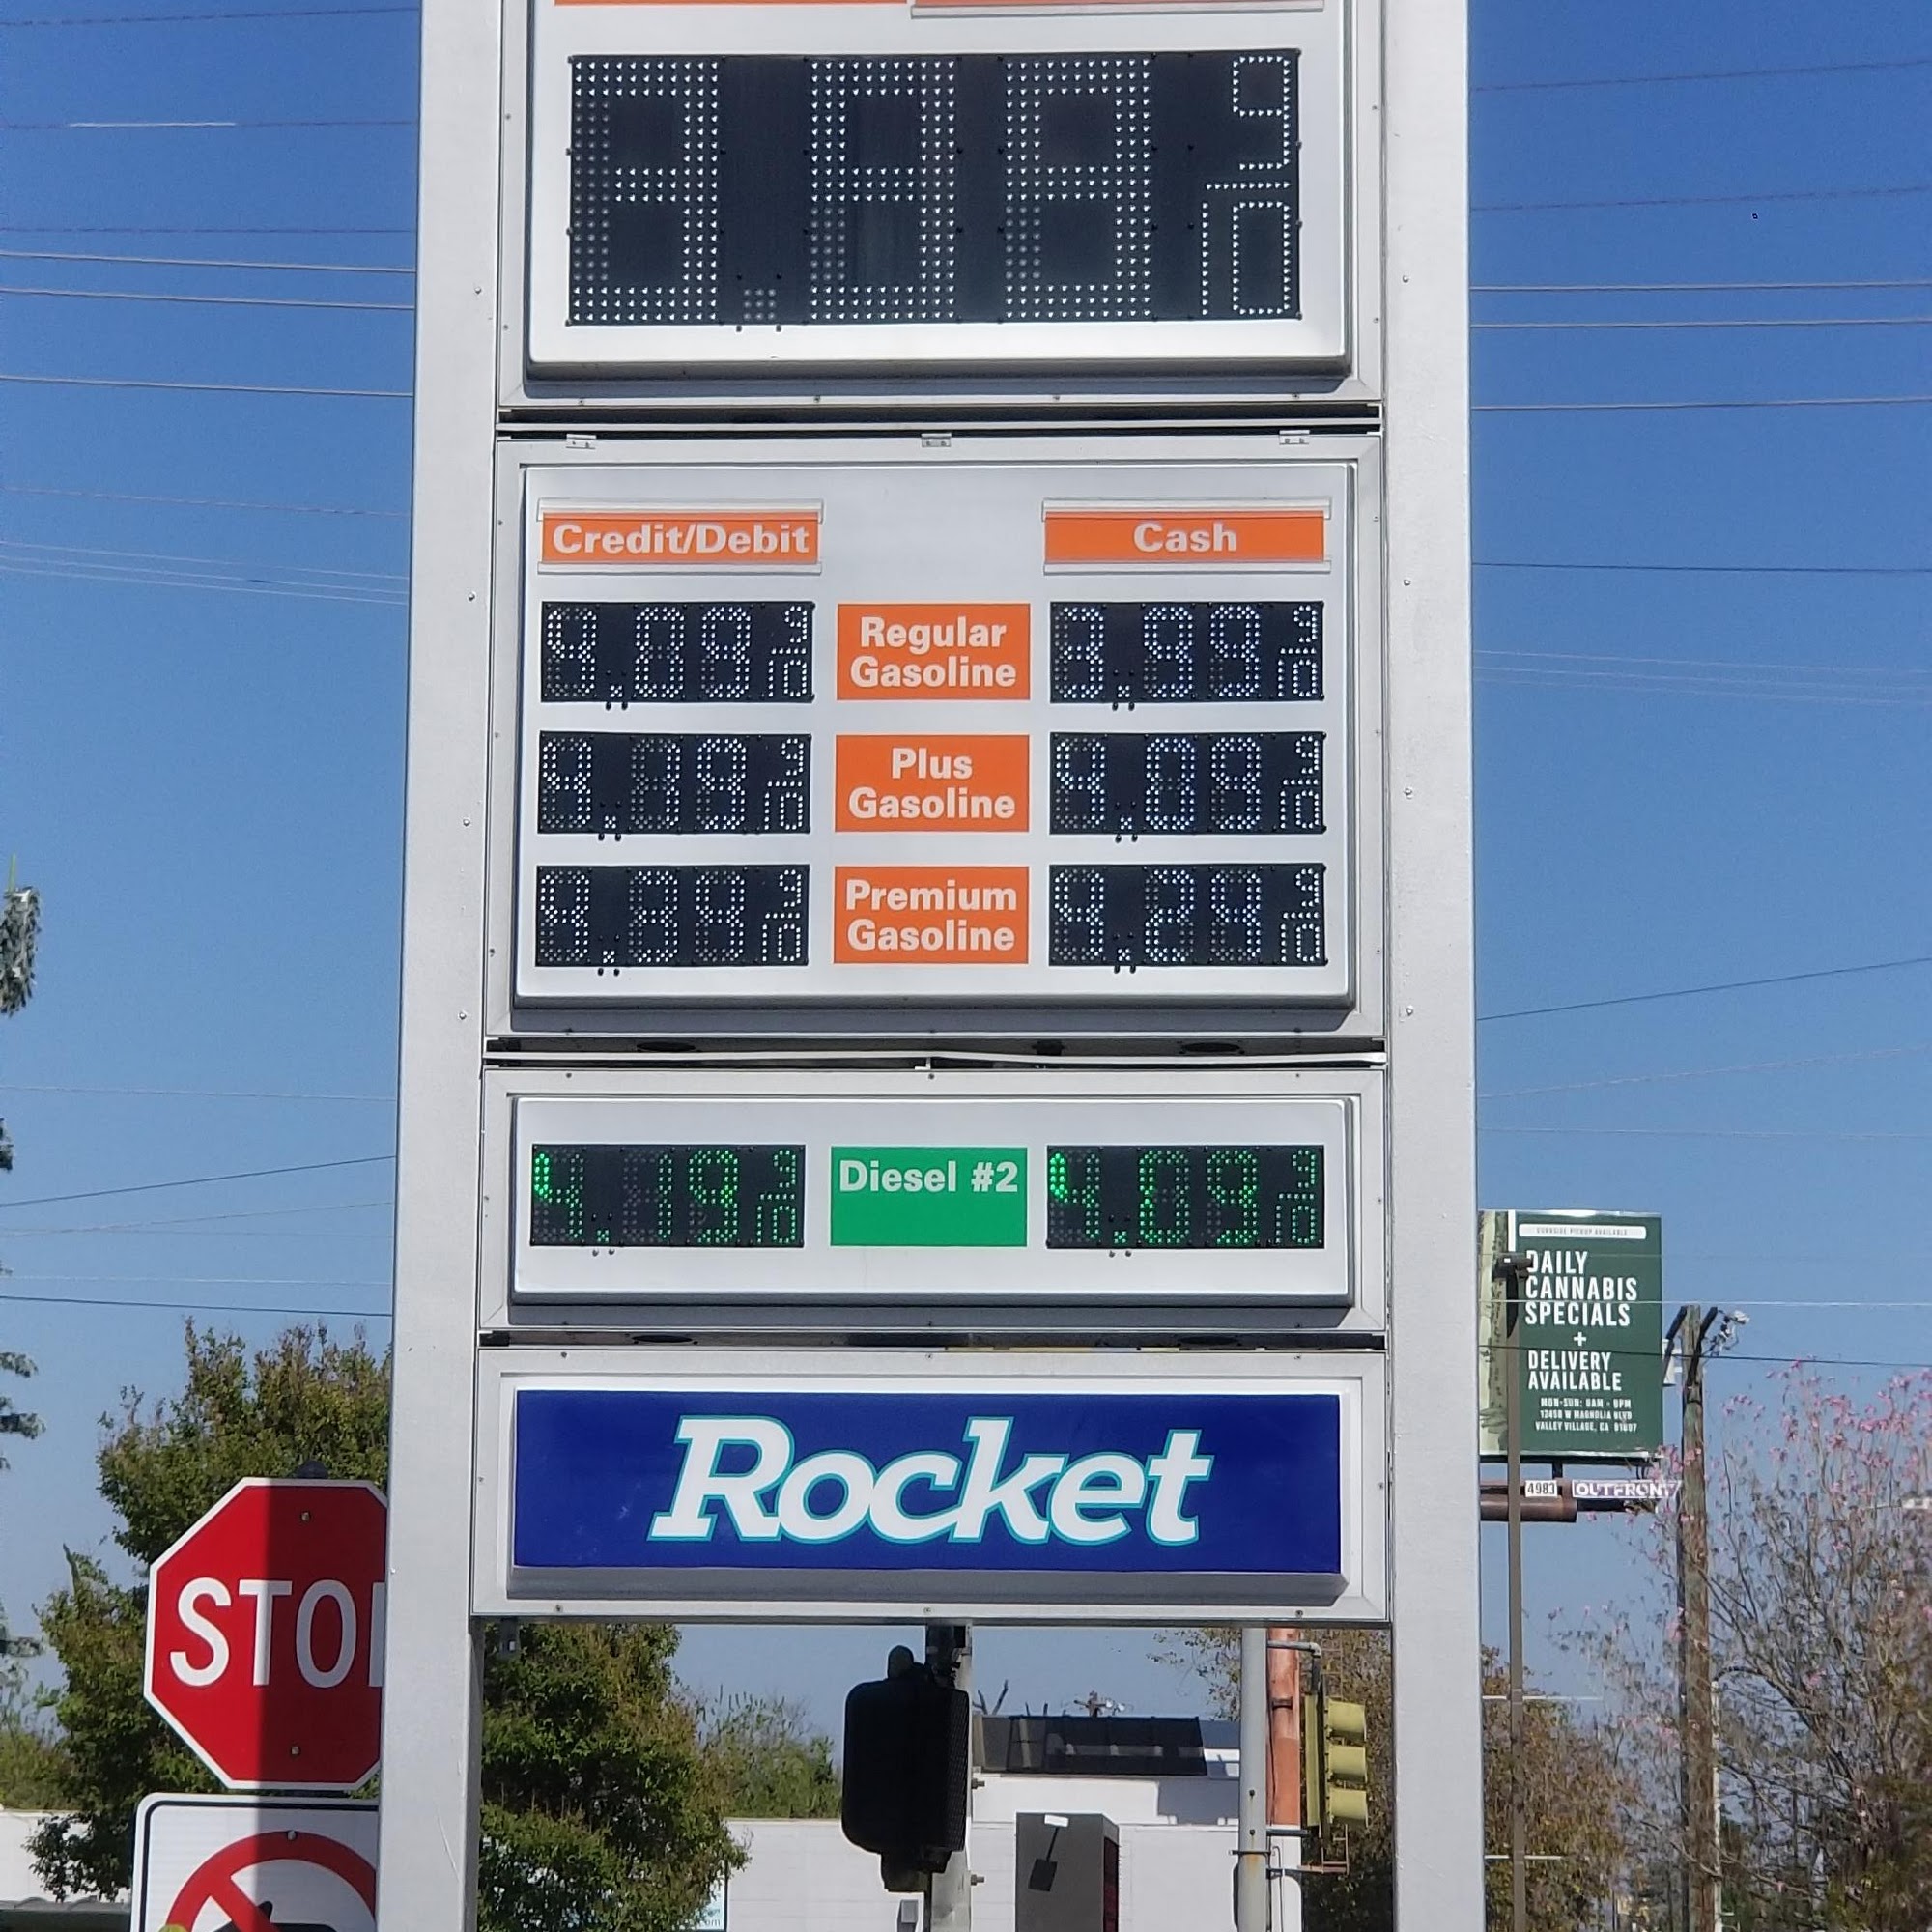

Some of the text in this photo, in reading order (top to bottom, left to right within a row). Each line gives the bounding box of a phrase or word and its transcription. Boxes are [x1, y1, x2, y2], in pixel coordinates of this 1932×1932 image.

[553, 523, 810, 554] Credit/Debit
[1133, 522, 1237, 552] Cash
[861, 615, 1007, 655] Regular
[850, 655, 1016, 687] Gasoline
[892, 747, 973, 779] Plus
[848, 786, 1015, 819] Gasoline
[845, 878, 1017, 911] Premium
[847, 918, 1015, 951] Gasoline
[839, 1159, 1018, 1192] Diesel #2
[533, 1150, 739, 1243] 4.19
[1049, 1150, 1258, 1244] 4.09
[1525, 1250, 1588, 1274] DAILY
[1525, 1276, 1637, 1301] CANNABIS
[1524, 1301, 1631, 1326] SPECIALS
[1528, 1350, 1611, 1371] DELIVERY
[1528, 1371, 1622, 1391] AVAILABLE
[1535, 1421, 1562, 1431] VALLEY
[647, 1414, 1212, 1544] Rocket
[1527, 1482, 1555, 1495] 4983
[170, 1577, 385, 1688] STO
